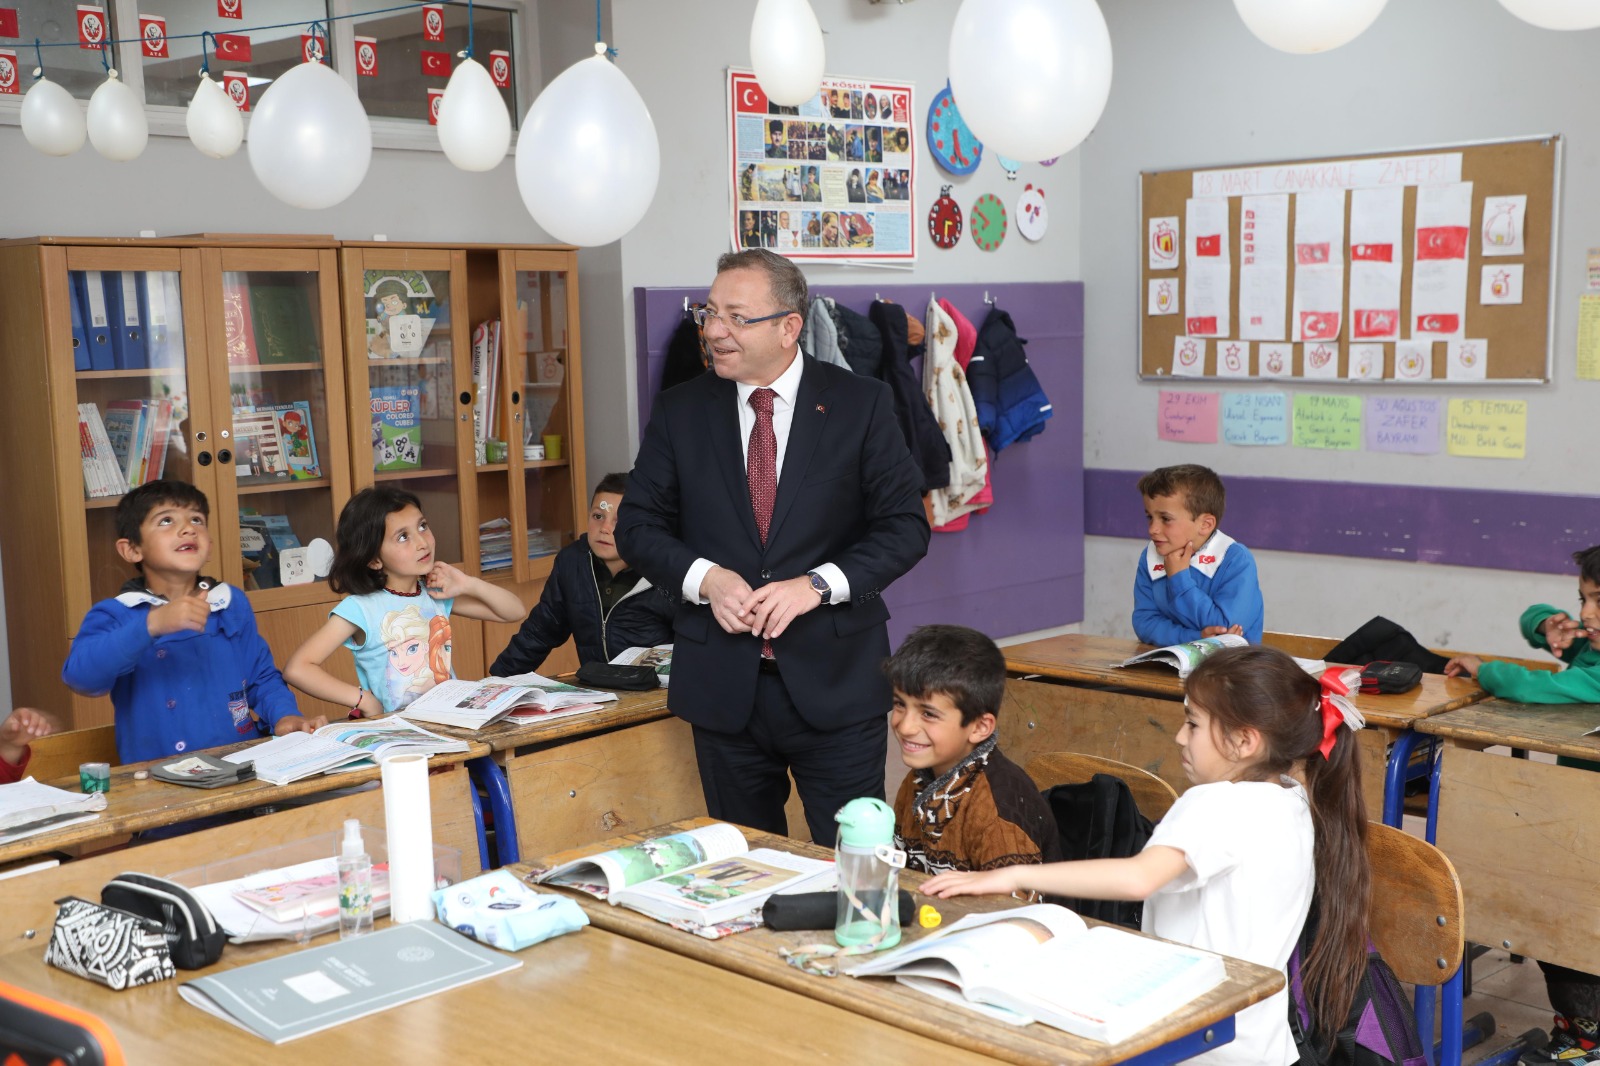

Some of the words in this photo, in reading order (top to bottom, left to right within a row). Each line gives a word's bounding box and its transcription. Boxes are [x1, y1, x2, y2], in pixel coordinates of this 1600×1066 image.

[1220, 170, 1262, 193] MART
[1166, 392, 1180, 405] 29
[386, 412, 415, 420] COLORED
[1381, 414, 1428, 430] ZAFER
